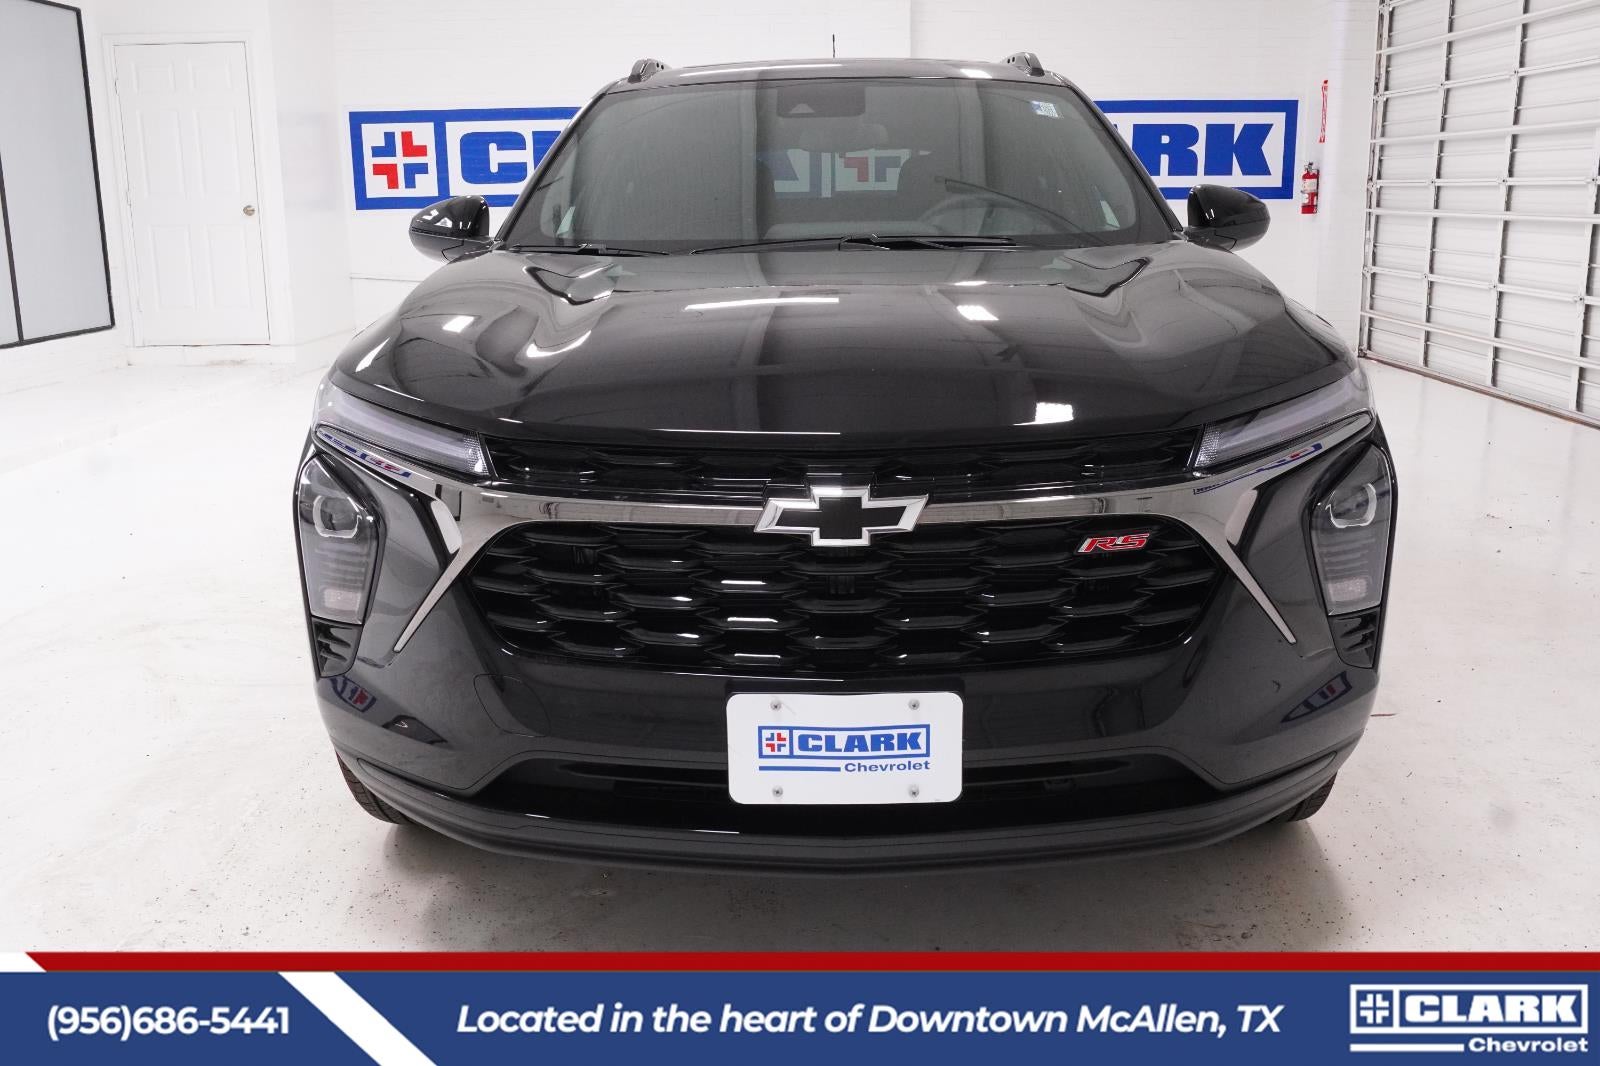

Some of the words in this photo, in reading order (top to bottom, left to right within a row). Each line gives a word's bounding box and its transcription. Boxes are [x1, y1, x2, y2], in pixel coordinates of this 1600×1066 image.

[1112, 123, 1274, 176] RK
[1077, 533, 1150, 553] RS
[797, 732, 922, 753] CLARK
[844, 760, 931, 773] Chevrolet
